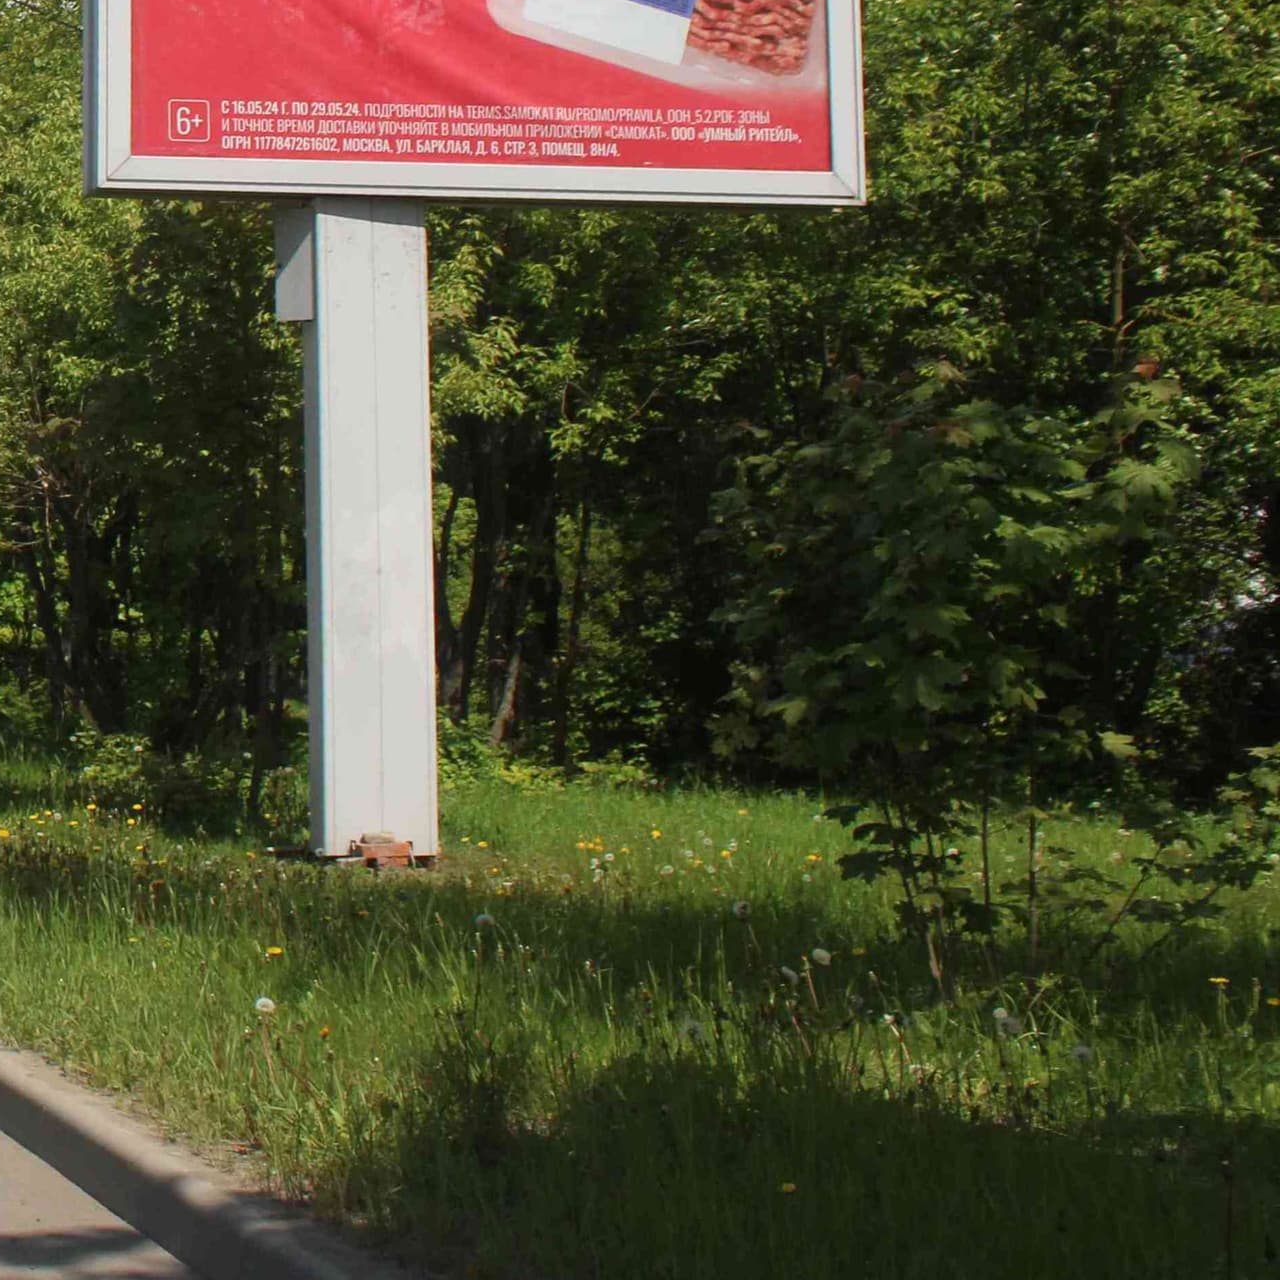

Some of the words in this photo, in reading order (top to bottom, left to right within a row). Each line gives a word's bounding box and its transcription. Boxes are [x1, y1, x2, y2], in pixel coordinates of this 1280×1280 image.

[175, 106, 203, 135] 6+
[232, 101, 279, 115] 16.05.24
[292, 102, 308, 116] ПО
[311, 102, 362, 117] 29.05.24.
[364, 104, 446, 119] ПОДРОБНОСТИ
[448, 105, 464, 118] НА
[737, 110, 770, 124] ЗОНЫ
[221, 118, 230, 131] И
[232, 118, 274, 132] ТОЧНОЕ
[277, 119, 315, 133] ВРЕМЯ
[318, 120, 376, 135] ДОСТАВКИ
[378, 120, 439, 136] УТОЧНЯЙТЕ
[441, 122, 449, 136] В
[451, 122, 523, 137] МОБИЛЬНОМ
[525, 124, 602, 138] ПРИЛОЖЕНИИ
[671, 127, 696, 141] ООО
[222, 135, 251, 149] ОГРН
[396, 139, 414, 154] УЛ.
[416, 140, 473, 155] БАРКЛАЯ,
[504, 141, 526, 155] СТР.
[542, 142, 588, 158] ПОМЕЩ.
